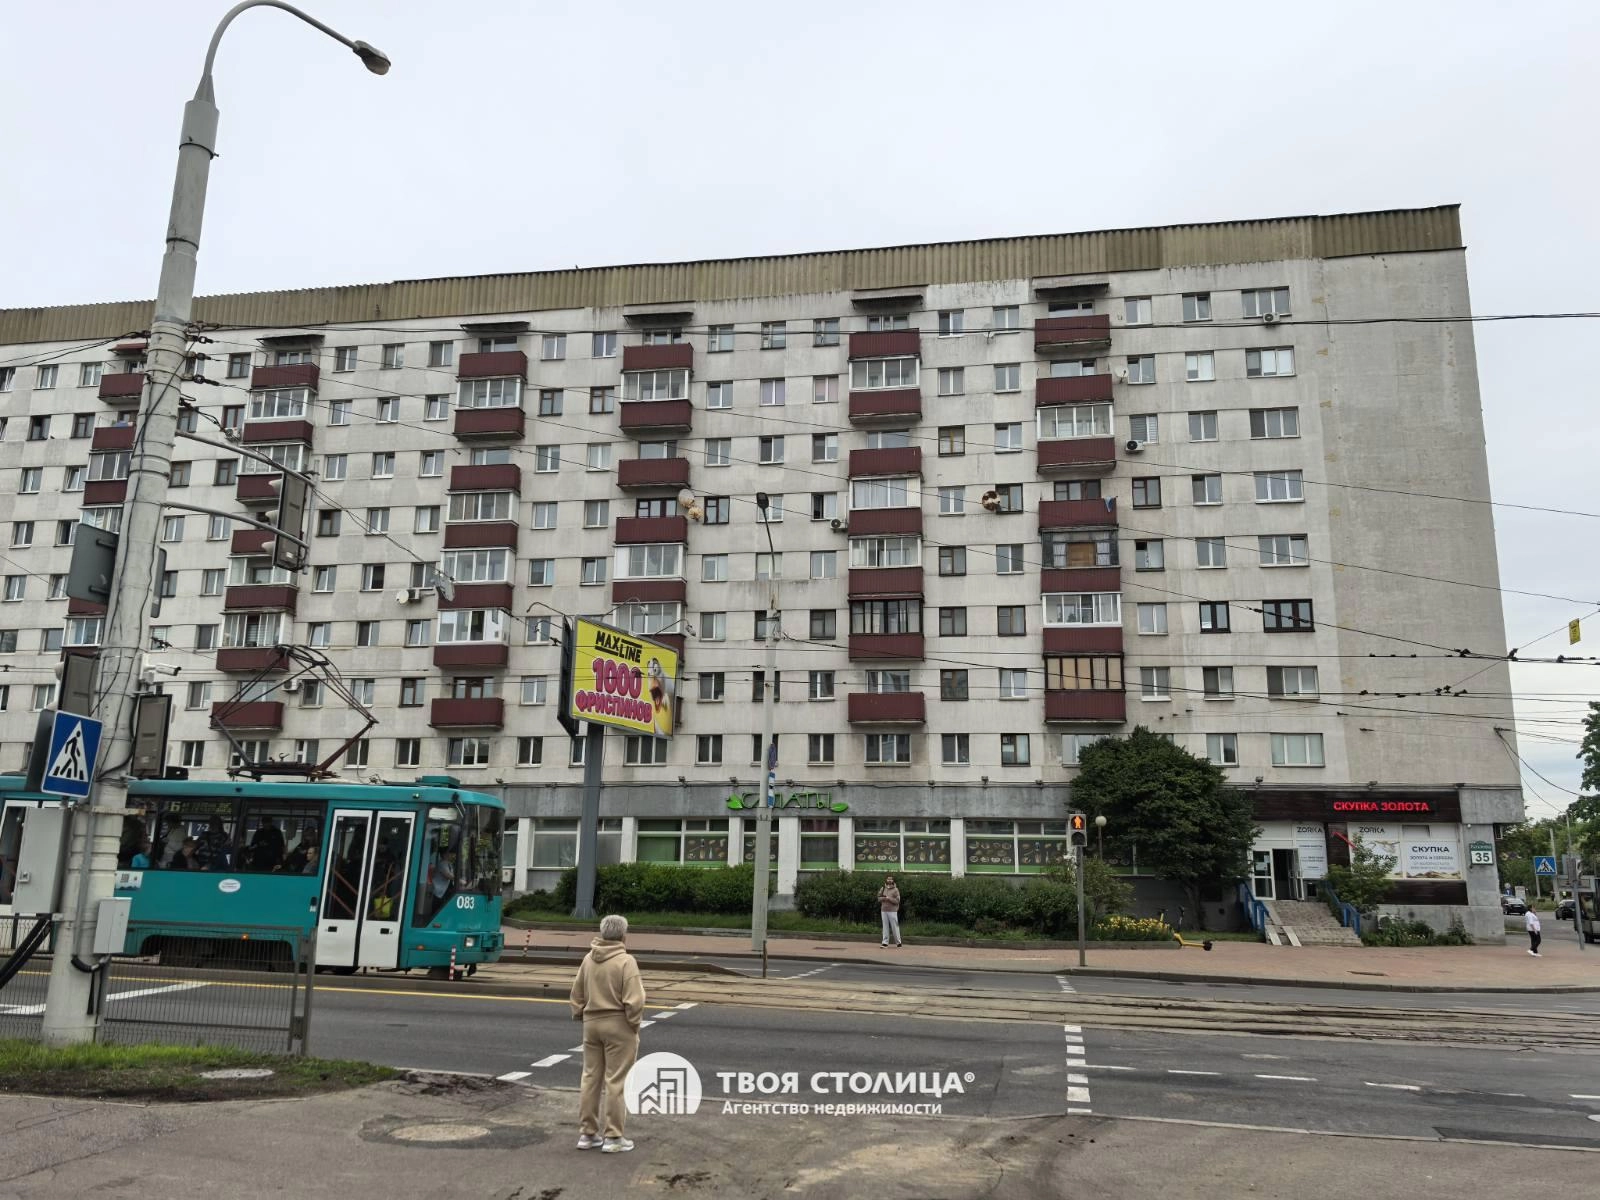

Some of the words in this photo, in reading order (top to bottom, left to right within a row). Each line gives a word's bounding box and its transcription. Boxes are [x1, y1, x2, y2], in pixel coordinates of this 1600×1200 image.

[595, 630, 642, 663] MAXLINE
[593, 658, 642, 698] 1000
[575, 690, 652, 723] ФРИСПИНОВ
[742, 791, 831, 808] СЛАТЫ
[1333, 801, 1378, 811] СКУПКА
[1380, 802, 1429, 811] ЗОЛОТА
[1475, 852, 1490, 862] 35
[456, 896, 475, 909] 083
